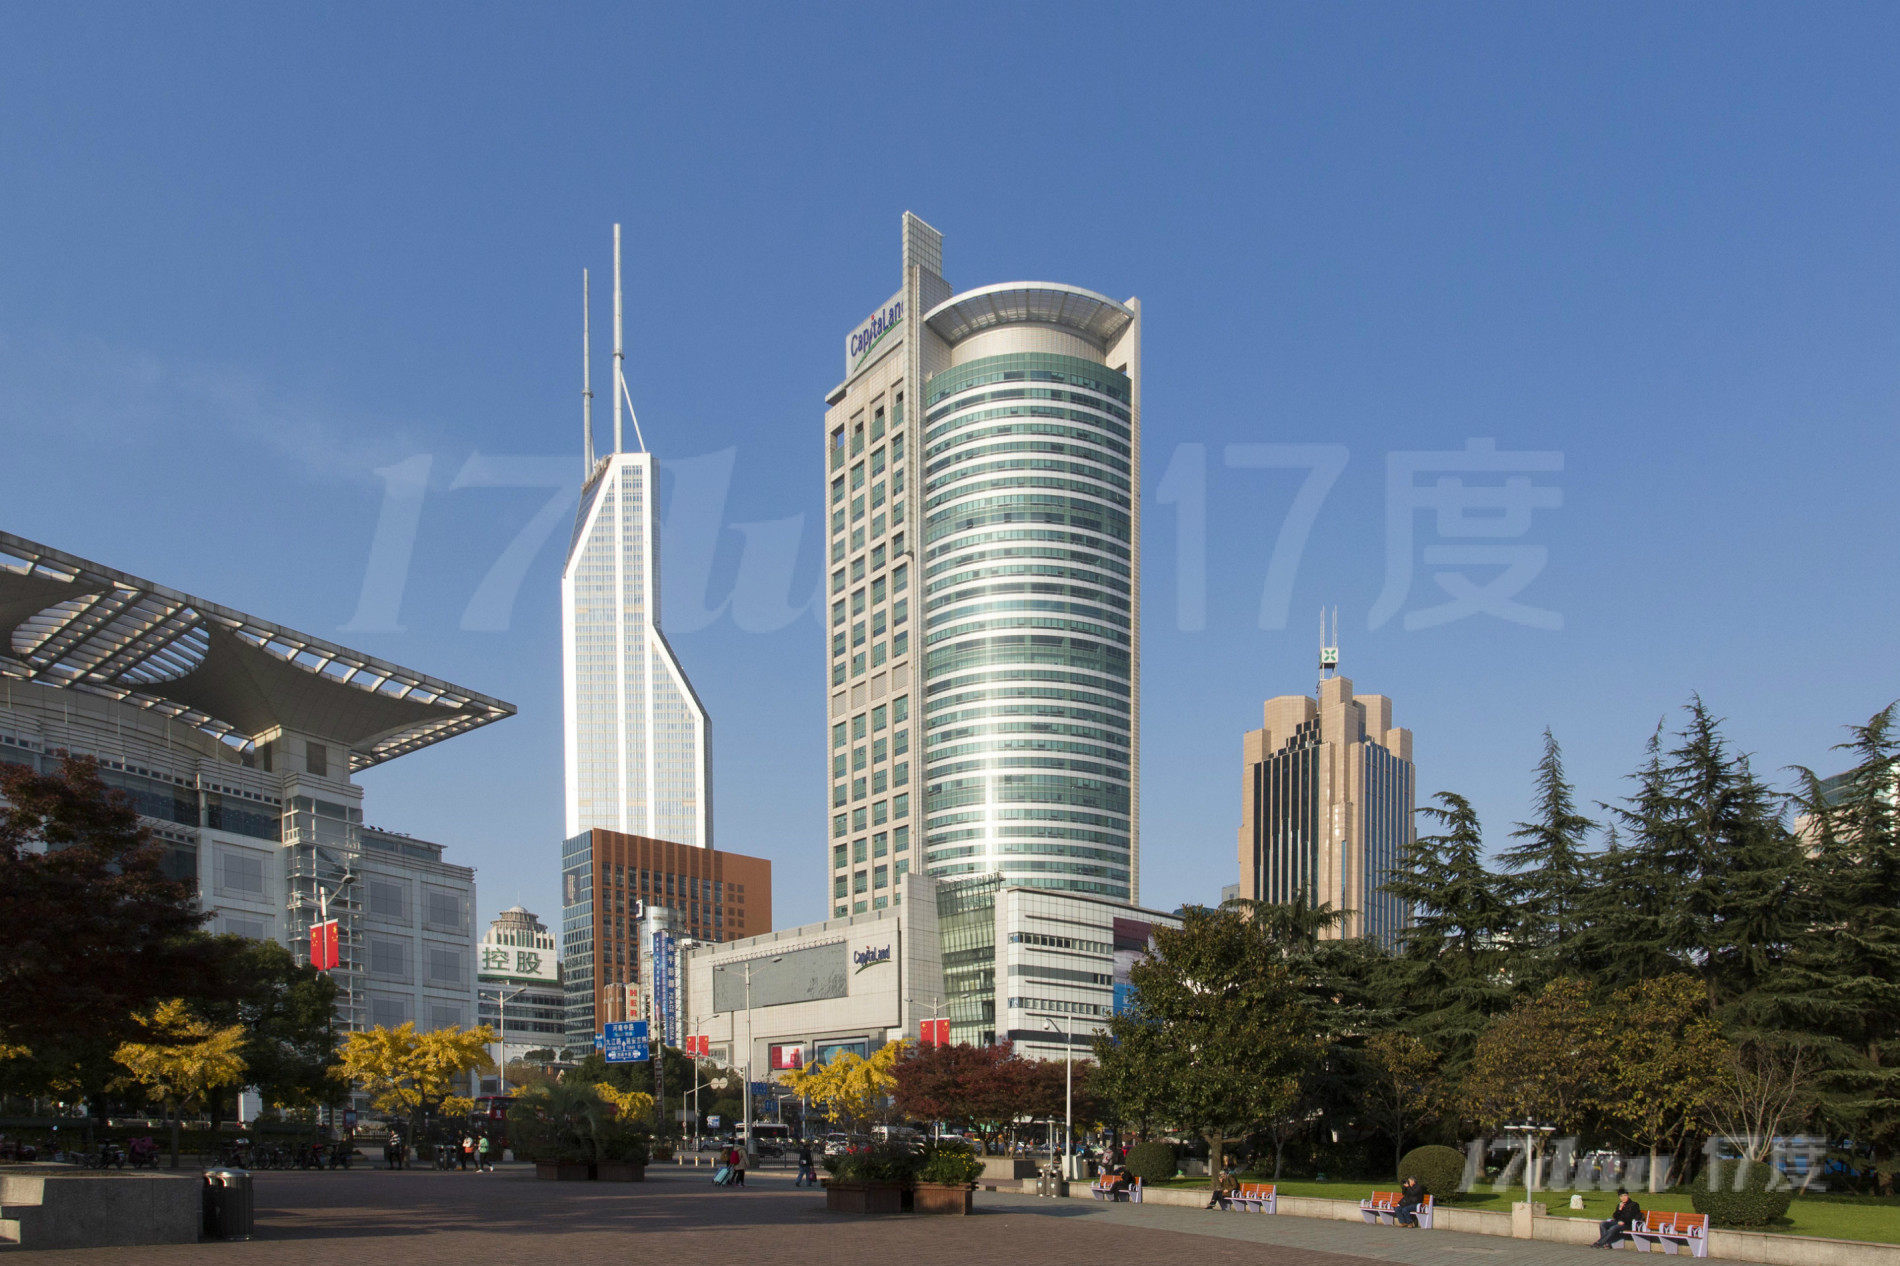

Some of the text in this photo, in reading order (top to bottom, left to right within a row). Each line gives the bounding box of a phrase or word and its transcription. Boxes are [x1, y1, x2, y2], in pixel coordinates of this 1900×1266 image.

[851, 300, 904, 357] CapitaLan
[482, 946, 543, 976] 控股
[853, 943, 891, 966] CapitaLand
